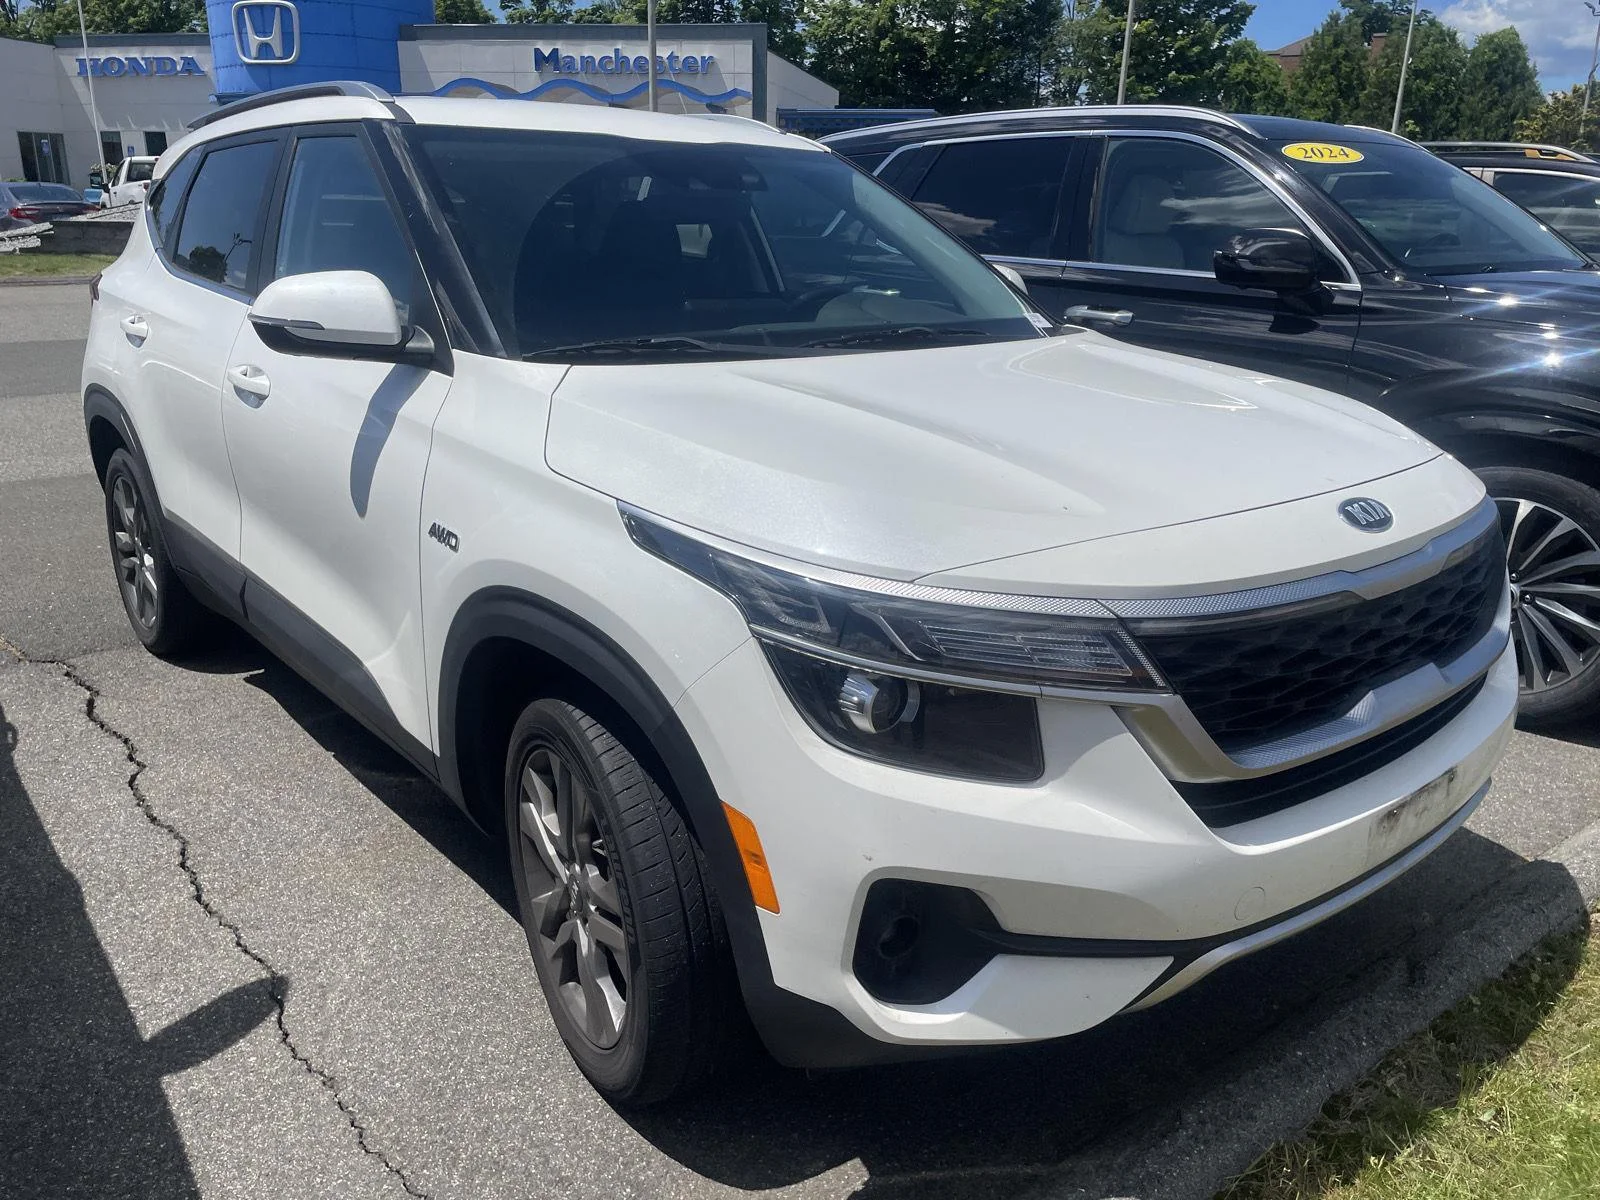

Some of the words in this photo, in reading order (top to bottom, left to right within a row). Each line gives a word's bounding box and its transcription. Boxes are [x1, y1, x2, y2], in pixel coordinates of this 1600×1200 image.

[75, 56, 206, 77] HONDA
[533, 47, 716, 75] Manchester
[1297, 147, 1350, 159] 2024
[1345, 500, 1390, 525] KIA
[428, 522, 460, 553] AWD
